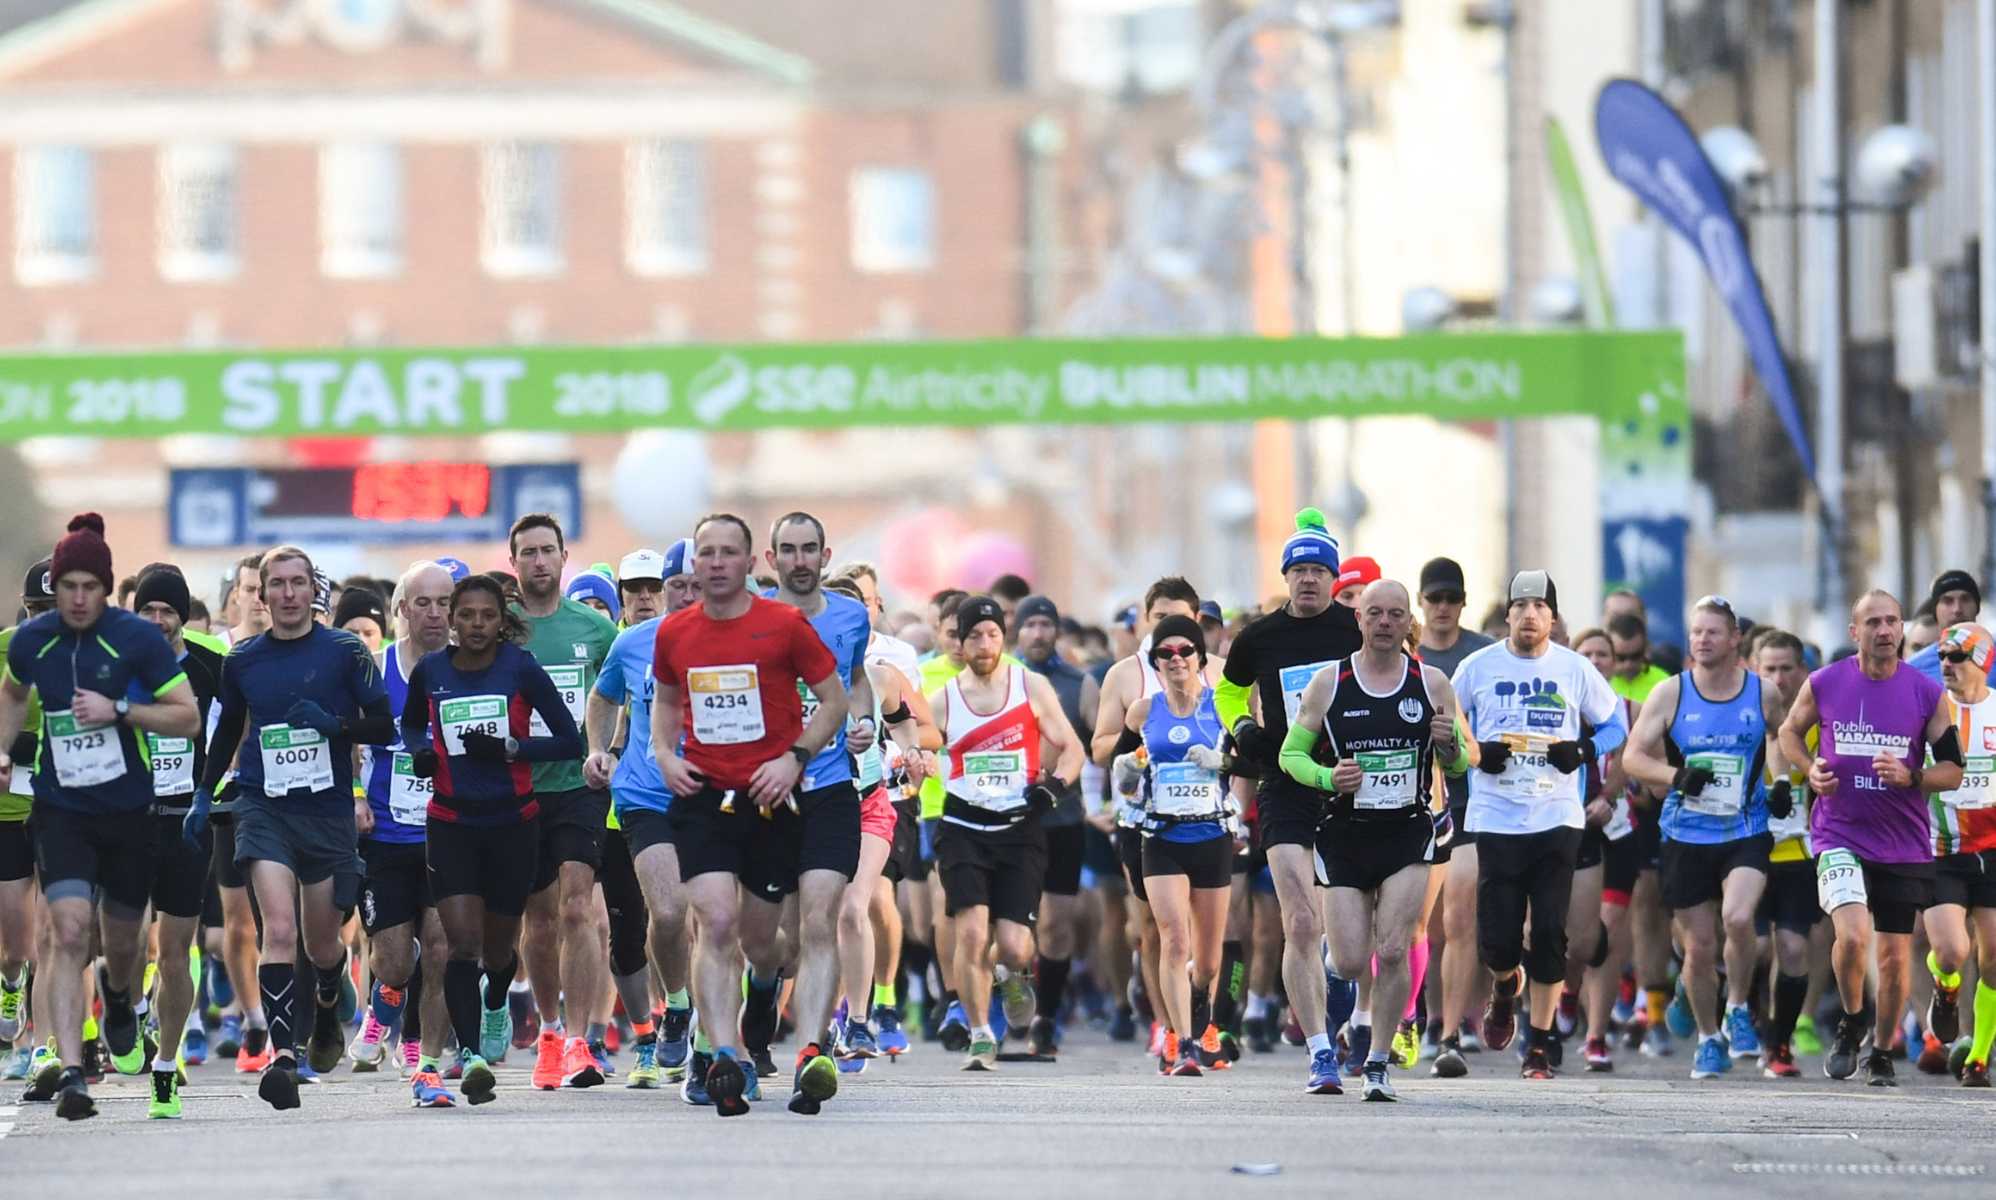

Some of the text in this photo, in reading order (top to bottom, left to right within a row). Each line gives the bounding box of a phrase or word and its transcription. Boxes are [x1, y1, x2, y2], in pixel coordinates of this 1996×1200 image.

[68, 378, 186, 421] 2018
[221, 359, 524, 428] START
[555, 372, 671, 415] 2018
[862, 364, 1052, 417] Airtricity
[1061, 360, 1249, 405] DUBLIN
[1253, 358, 1522, 404] MARATHON
[704, 694, 748, 709] 4234
[454, 721, 498, 737] 7648
[62, 732, 105, 753] 7923
[1345, 739, 1401, 750] MOYNALTY
[1833, 731, 1912, 747] MARATHON
[275, 747, 318, 765] 6007
[976, 775, 1010, 787] 6771
[1370, 774, 1408, 788] 7491
[1854, 775, 1887, 790] BILL
[1166, 785, 1210, 798] 12265
[1822, 867, 1855, 886] 8877
